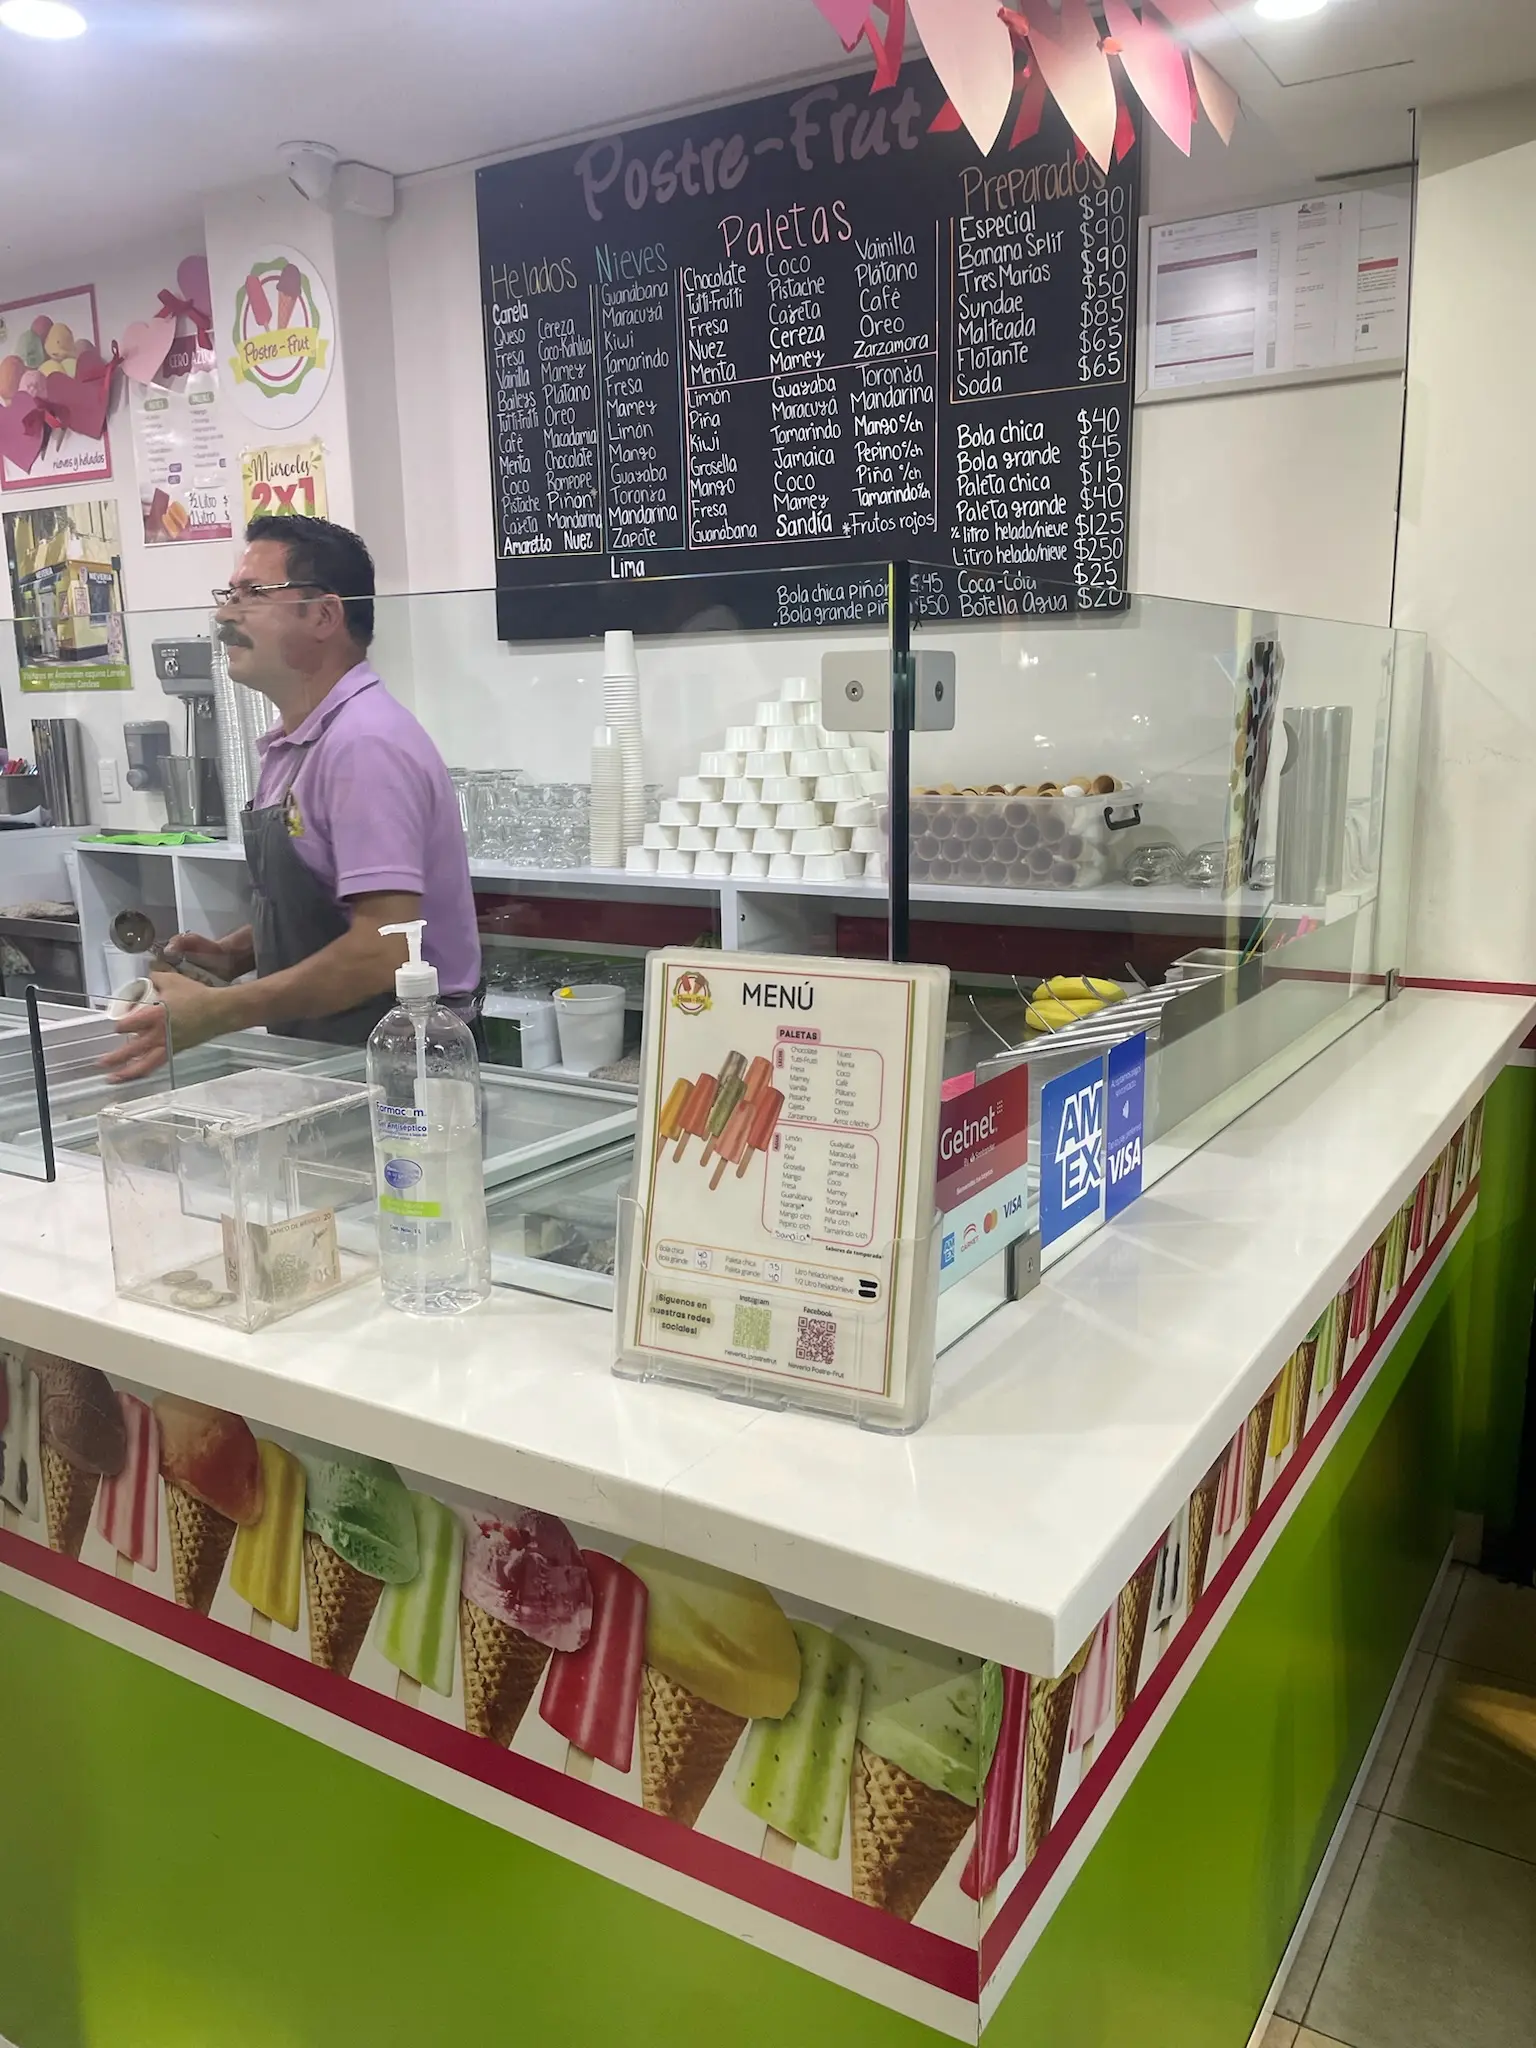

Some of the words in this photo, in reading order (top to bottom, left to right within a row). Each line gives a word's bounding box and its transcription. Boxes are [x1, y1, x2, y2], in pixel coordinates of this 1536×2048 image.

[573, 86, 923, 220] Postre-Frut
[958, 149, 1106, 215] Preparados
[959, 204, 1036, 243] Especial
[1079, 186, 1124, 220] $90
[717, 200, 852, 258] Paletas
[855, 231, 916, 261] Vainilla
[958, 240, 1023, 270] Banana
[1025, 230, 1065, 257] Split
[1079, 215, 1125, 248] $90
[595, 243, 668, 283] Nieves
[765, 252, 811, 278] Coco
[958, 270, 997, 293] Tres
[1081, 244, 1126, 274] $90
[490, 256, 578, 301] Helados
[683, 262, 747, 292] Chocolate
[767, 275, 826, 301] Pistache
[860, 287, 901, 313] Café
[958, 292, 1023, 320] Sundae
[1082, 270, 1126, 300] $50
[492, 300, 529, 326] Canela
[768, 299, 821, 325] Cajeta
[958, 312, 1036, 346] Malteada
[1080, 295, 1123, 329] $85
[494, 325, 526, 348] Queso
[537, 318, 575, 340] Cereza
[688, 317, 729, 337] Fresa
[769, 324, 826, 350] Cereza
[860, 315, 905, 338] Oreo
[604, 330, 634, 350] Kiwi
[688, 340, 727, 361] Nuez
[854, 333, 929, 360] Zarzamora
[957, 341, 1029, 371] Flotante
[1078, 325, 1122, 354] $65
[495, 345, 525, 367] Fresa
[604, 351, 669, 375] Tamarindo
[770, 349, 826, 373] Mamey
[495, 367, 530, 390] Vainilla
[540, 362, 586, 384] Mamey
[691, 360, 736, 385] Menta
[856, 361, 924, 388] Toronja
[957, 370, 1003, 397] Soda
[1077, 351, 1121, 382] $65
[605, 377, 643, 398] Fresa
[772, 374, 837, 399] Guayaba
[850, 384, 934, 413] Mandarina
[497, 389, 537, 412] Baileys
[606, 399, 657, 419] Mamey
[545, 405, 576, 427] Oreo
[689, 410, 721, 430] Piña
[854, 415, 898, 437] Mango
[543, 427, 597, 450] Macadamia
[770, 422, 842, 446] Tamarindo
[956, 424, 996, 450] Bola
[999, 419, 1045, 446] chica
[1076, 407, 1121, 436] $40
[499, 431, 524, 453] Café
[690, 431, 720, 452] Kiwi
[854, 440, 901, 462] Pepino
[500, 454, 531, 476] Menta
[545, 449, 594, 471] Chocolate
[609, 444, 657, 464] Mango
[691, 455, 737, 474] Grosella
[772, 447, 836, 469] Jamaica
[956, 449, 998, 475] Bola
[1002, 442, 1061, 467] grande
[1077, 434, 1122, 460] $45
[503, 476, 530, 496] Coco
[546, 471, 592, 491] Rompope
[610, 465, 667, 486] Guayaba
[773, 471, 815, 492] Coco
[856, 464, 893, 484] Piña
[956, 473, 1006, 497] Paleta
[1009, 472, 1051, 492] chica
[1079, 459, 1122, 486] $15
[610, 487, 666, 507] Toronja
[691, 477, 736, 498] Mango
[852, 483, 918, 507] Tamarindo
[502, 495, 541, 515] Pistache
[692, 499, 727, 519] Fresa
[773, 490, 830, 512] Mamey
[955, 498, 1010, 523] Paleta
[1014, 494, 1067, 520] grande
[1079, 482, 1124, 512] $40
[503, 515, 539, 535] Cajeta
[547, 511, 602, 531] Mandarina
[609, 504, 678, 526] Mandarina
[776, 510, 833, 538] Sandía
[899, 511, 934, 535] rojos
[962, 525, 989, 543] litro
[995, 519, 1069, 542] helado/nieve
[1075, 511, 1124, 538] $125
[503, 535, 552, 556] Amaretto
[563, 530, 593, 550] Nuez
[612, 528, 658, 549] Zapote
[953, 547, 993, 567] Litro
[996, 543, 1068, 564] helado/nieve
[1074, 537, 1124, 562] $250
[610, 555, 645, 580] Lima
[1074, 562, 1118, 586] $25
[776, 584, 809, 605] Bola
[811, 582, 845, 603] chica
[958, 594, 1019, 618] Botella
[1022, 592, 1068, 614] Agua
[1077, 586, 1123, 609] $20
[777, 604, 812, 625] Bola
[814, 601, 863, 625] grande
[742, 981, 814, 1010] MENÚ
[779, 1029, 818, 1040] PALETAS
[940, 1105, 996, 1161] Getnet
[1108, 1136, 1141, 1185] VISA
[1003, 1195, 1022, 1219] VISA
[687, 1313, 711, 1324] redes
[803, 1306, 833, 1318] Facebook
